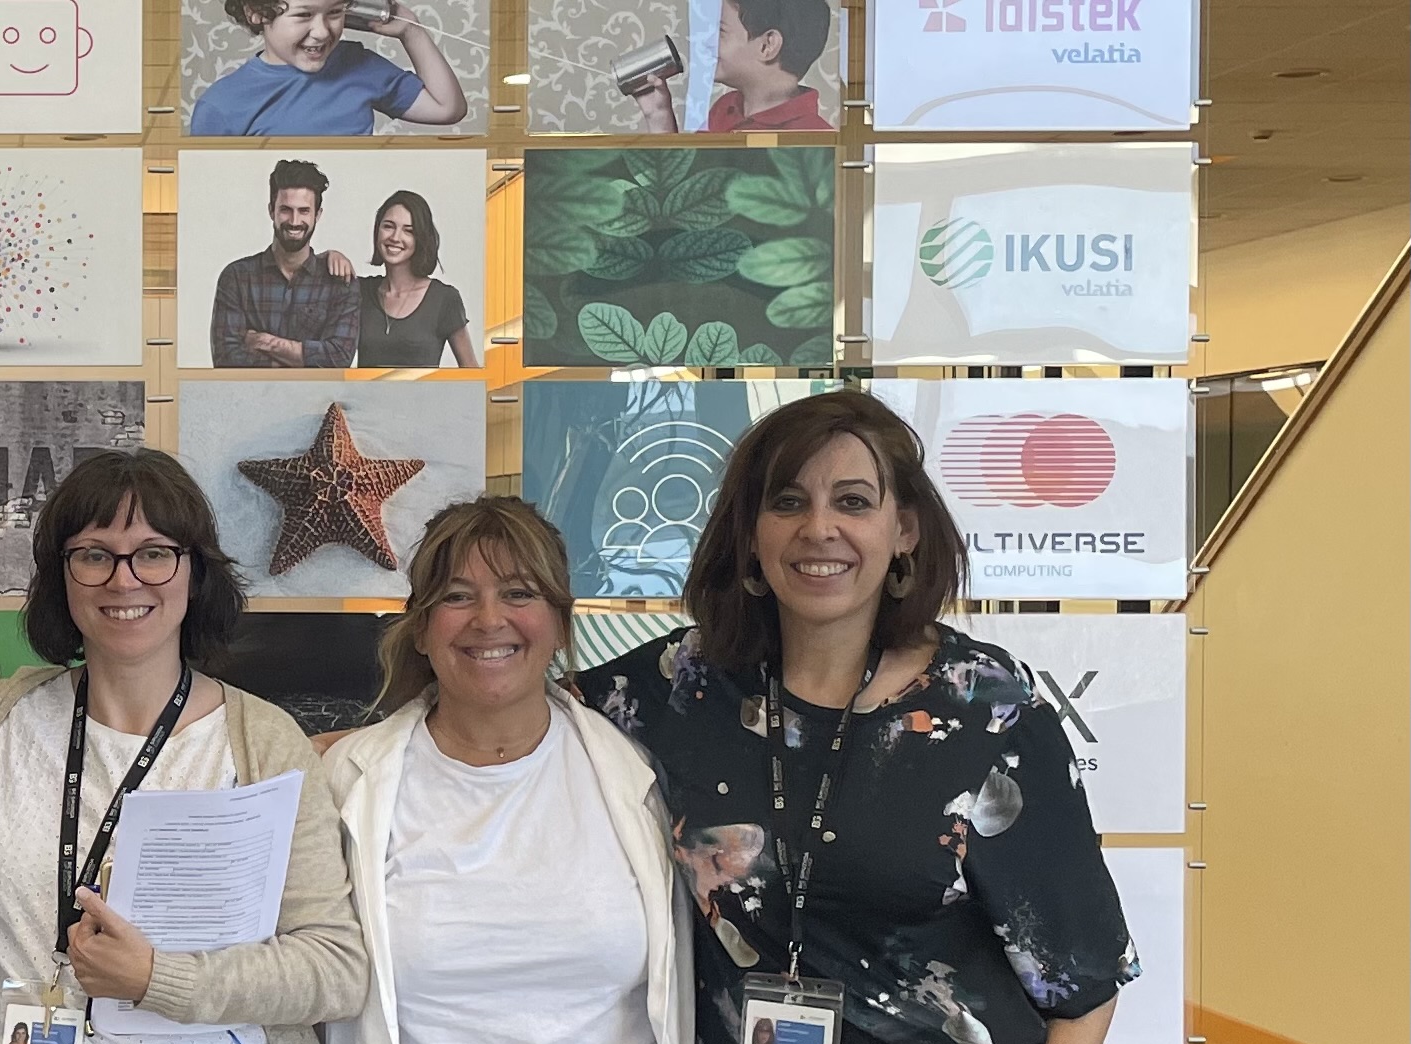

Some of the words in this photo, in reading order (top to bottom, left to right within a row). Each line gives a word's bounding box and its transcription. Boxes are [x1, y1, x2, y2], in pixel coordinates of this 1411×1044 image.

[1051, 42, 1141, 64] velatia
[1005, 233, 1133, 272] IKUSI
[1061, 279, 1133, 297] velatia
[965, 533, 1145, 554] LTIVERSE
[983, 564, 1073, 578] COMPUTING
